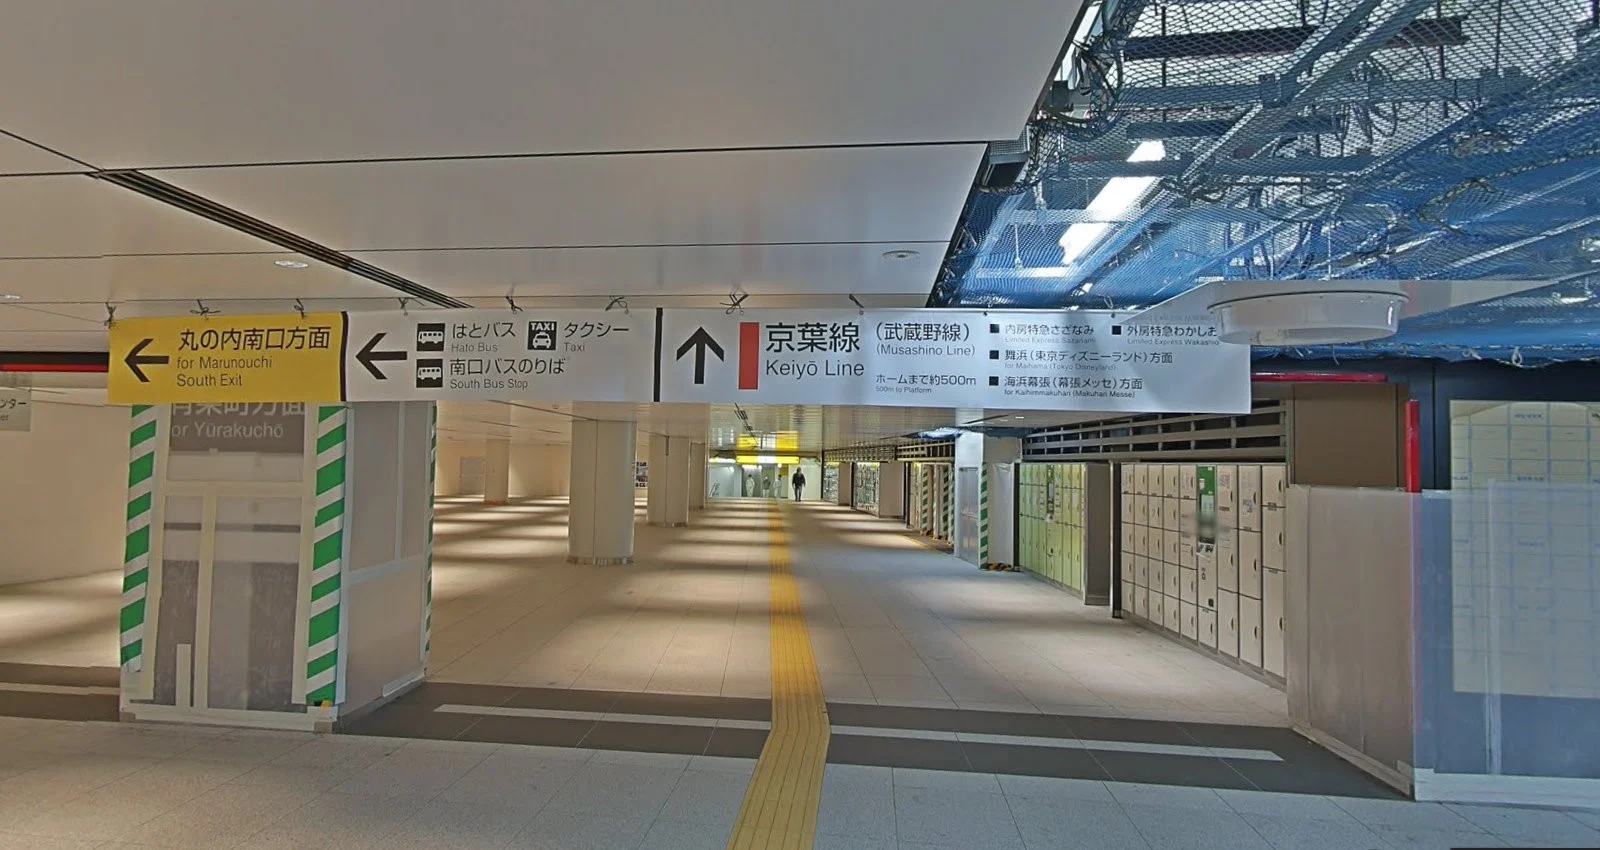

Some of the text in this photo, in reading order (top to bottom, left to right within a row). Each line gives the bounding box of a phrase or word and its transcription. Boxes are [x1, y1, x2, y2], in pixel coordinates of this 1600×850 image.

[452, 322, 516, 339] はとバス
[530, 322, 555, 331] TAXI
[563, 322, 630, 338] タクシー
[876, 322, 970, 342] （武蔵野線）
[1005, 324, 1094, 336] 内房特急さざなみ
[178, 326, 332, 351] 丸の内南口方面
[765, 322, 860, 353] 京葉線
[451, 342, 498, 352] Hato Bus
[563, 342, 586, 351] Taxi
[876, 344, 975, 356] (Musashino Line)
[177, 355, 273, 369] for Marunouchi
[450, 357, 567, 375] 南口バスのりば
[766, 359, 864, 380] Keiyō Line
[177, 373, 243, 387] South Exit
[450, 379, 528, 390] South Bus Stop
[876, 374, 976, 386] ホームまで約500m
[171, 421, 284, 438] or Yūrakuchō
